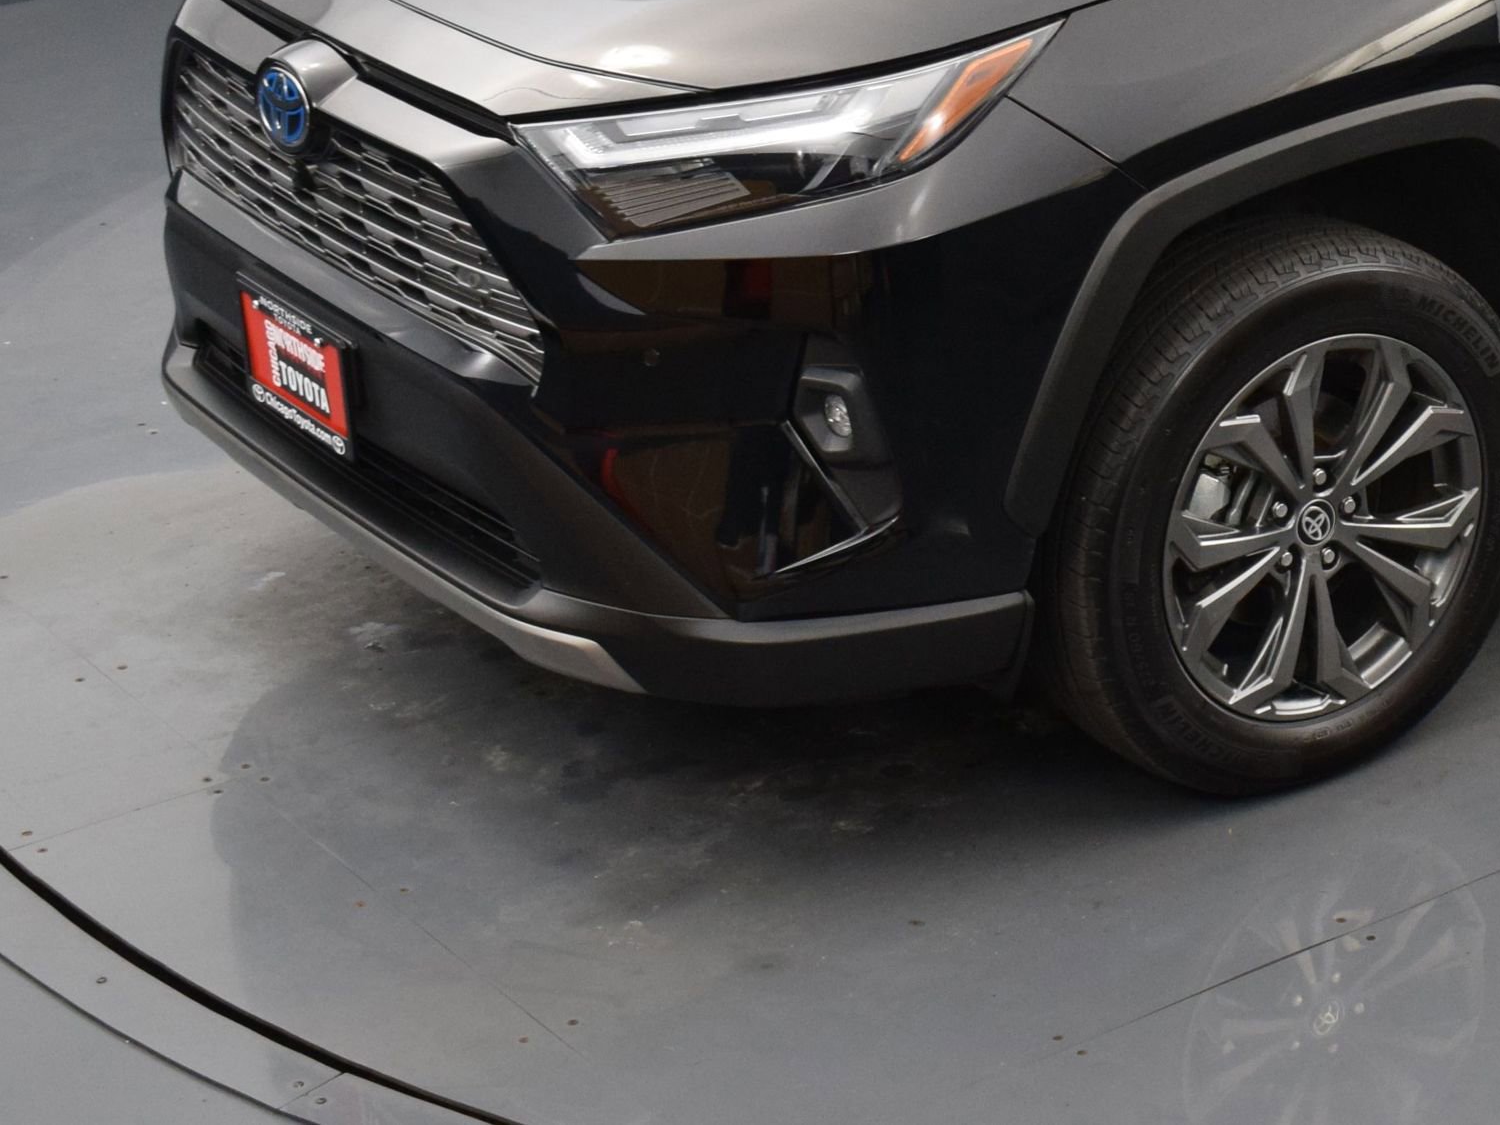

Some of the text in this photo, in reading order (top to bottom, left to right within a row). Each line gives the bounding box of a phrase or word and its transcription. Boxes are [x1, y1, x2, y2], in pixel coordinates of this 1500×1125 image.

[259, 296, 313, 334] NORTHSIDE
[1417, 295, 1500, 371] MICHELIN
[278, 360, 330, 413] TOYOTA
